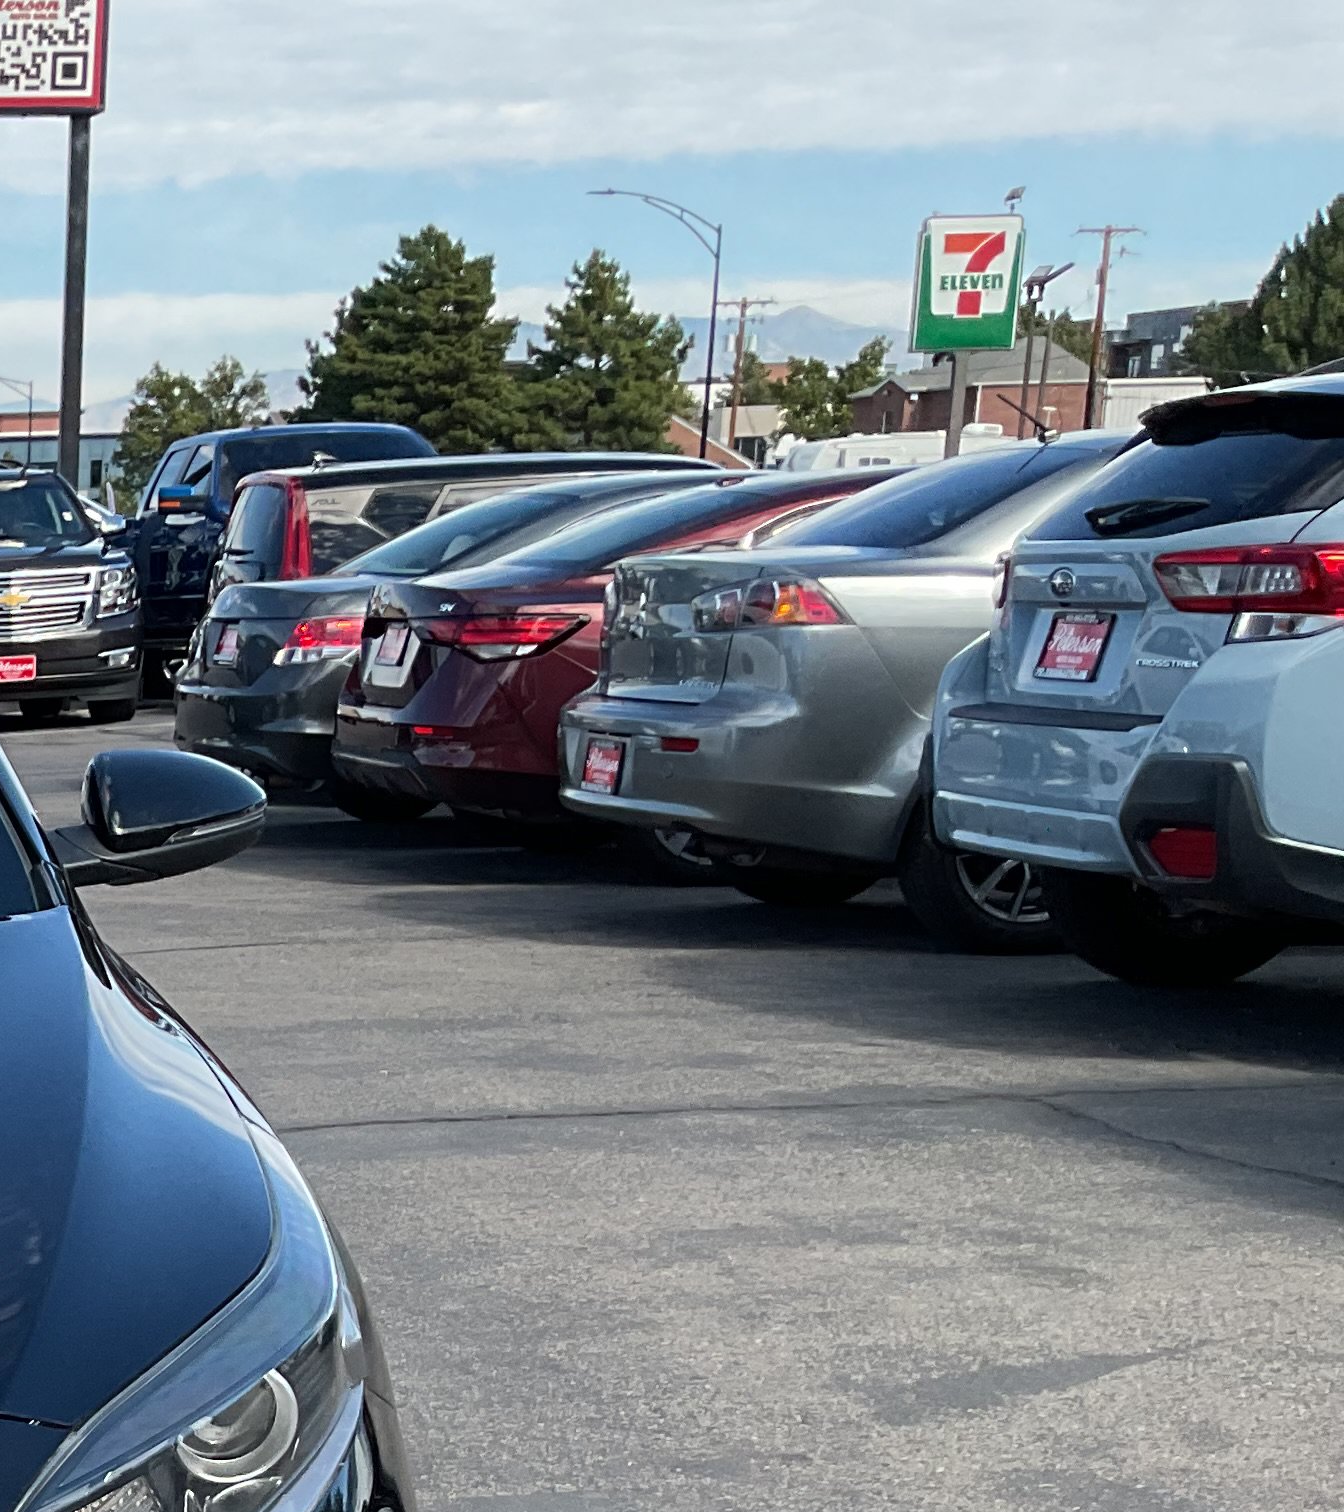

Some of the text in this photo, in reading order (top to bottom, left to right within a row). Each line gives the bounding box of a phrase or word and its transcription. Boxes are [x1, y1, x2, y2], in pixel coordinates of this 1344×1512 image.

[943, 231, 1006, 316] 7
[1047, 624, 1103, 655] Peterson
[1135, 658, 1199, 668] CROSSTREK
